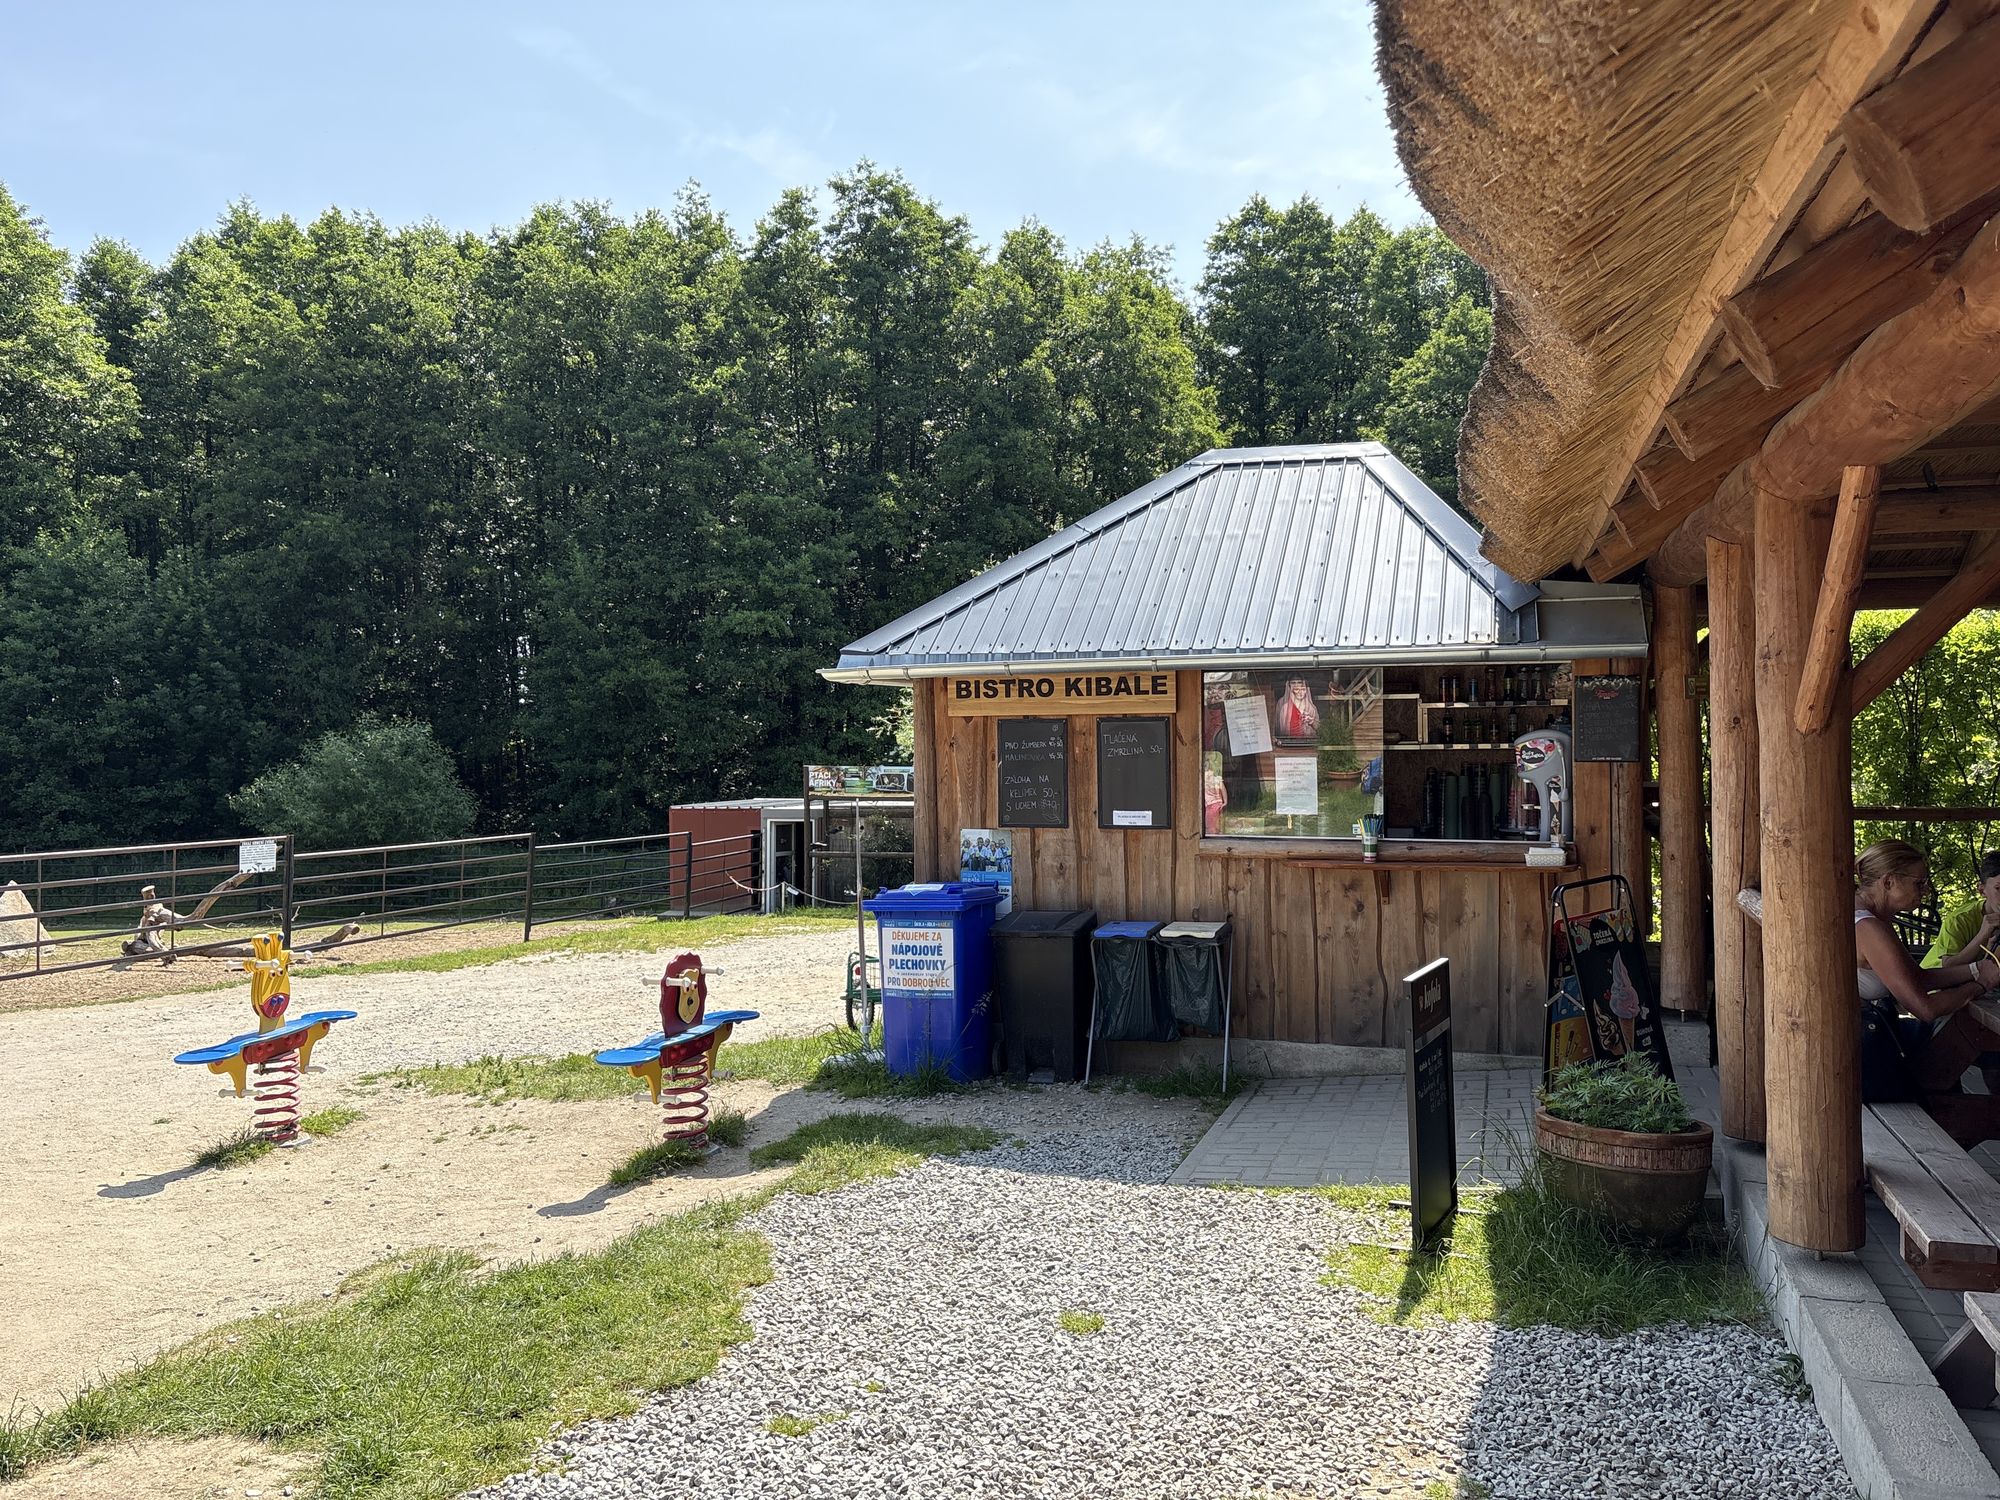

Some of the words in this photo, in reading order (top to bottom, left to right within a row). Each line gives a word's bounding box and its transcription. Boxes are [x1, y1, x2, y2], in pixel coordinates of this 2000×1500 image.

[956, 678, 1055, 699] BISTRO
[1065, 675, 1168, 698] KIBALE
[1004, 741, 1019, 750] PIVO
[1107, 746, 1145, 757] ZMRZLINA
[808, 779, 837, 787] AFRIKY
[1038, 774, 1050, 783] NA
[891, 930, 930, 941] DĚKUJEME
[932, 931, 942, 942] ZA
[891, 942, 943, 956] NÁPOJOVÉ
[888, 958, 947, 971] PLECHOVKY
[887, 976, 901, 986] PRO
[902, 976, 933, 988] DOBROU
[935, 976, 950, 988] VĚC
